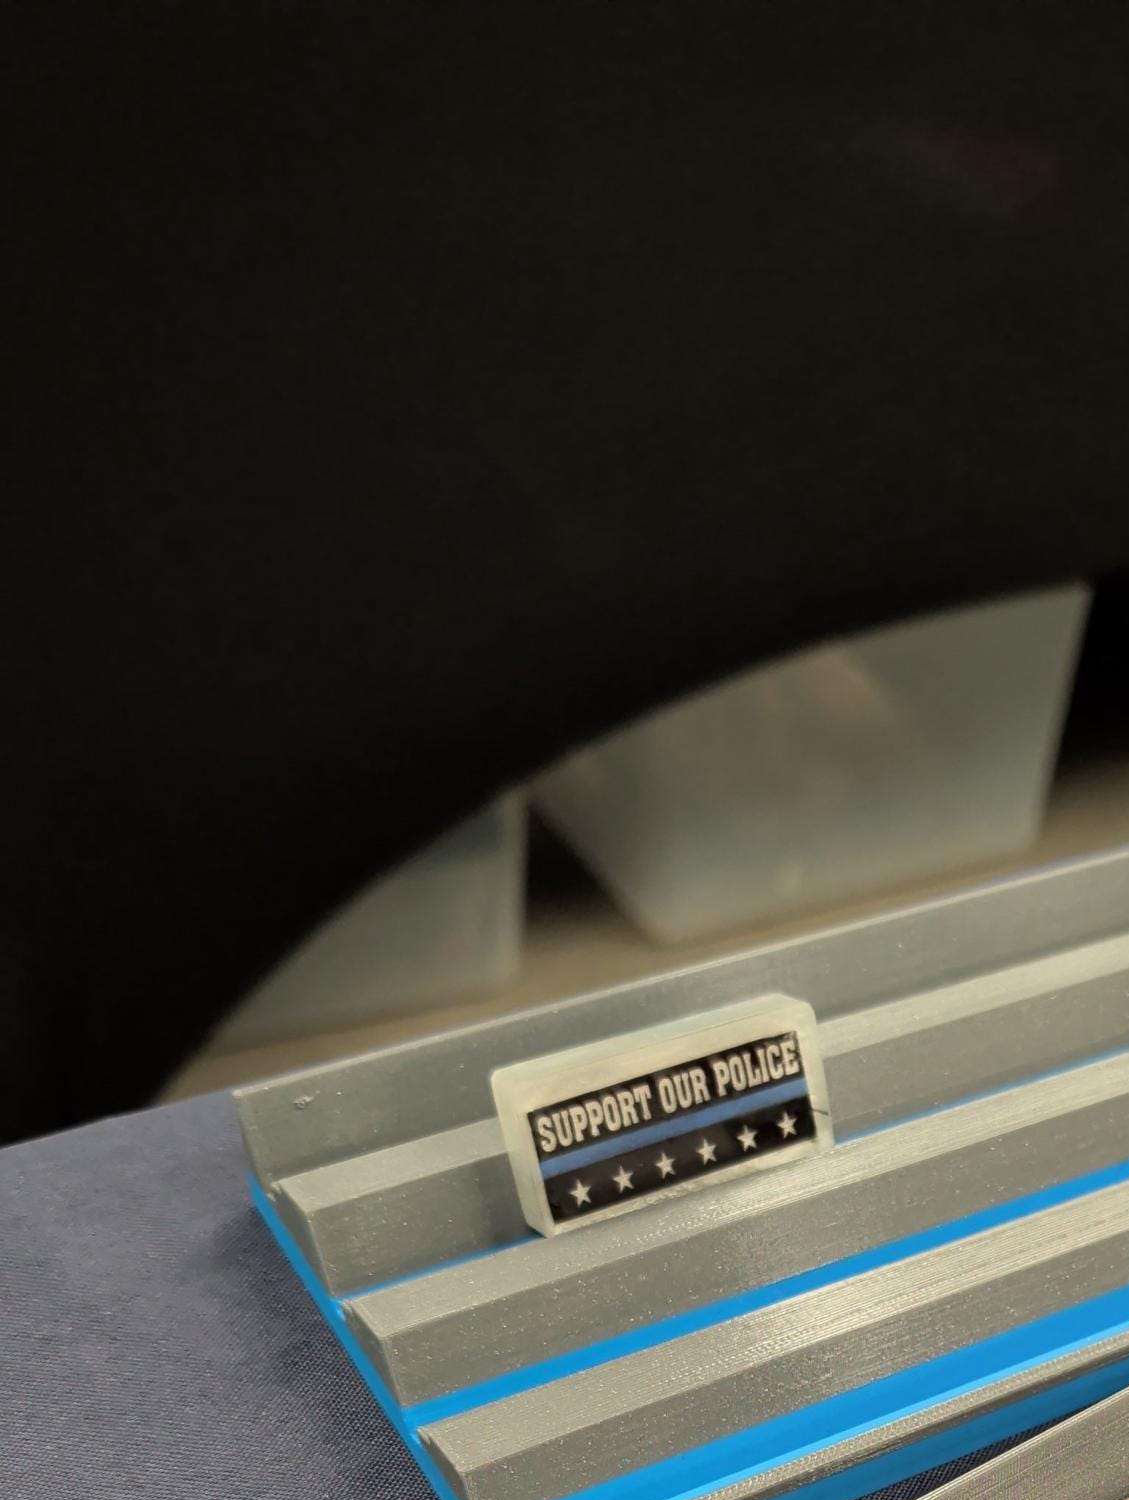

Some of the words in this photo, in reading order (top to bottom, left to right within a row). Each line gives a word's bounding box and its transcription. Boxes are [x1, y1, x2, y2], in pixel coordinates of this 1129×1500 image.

[536, 1083, 652, 1152] SUPPORT
[658, 1068, 710, 1114] OUR
[713, 1040, 800, 1097] POLICE
